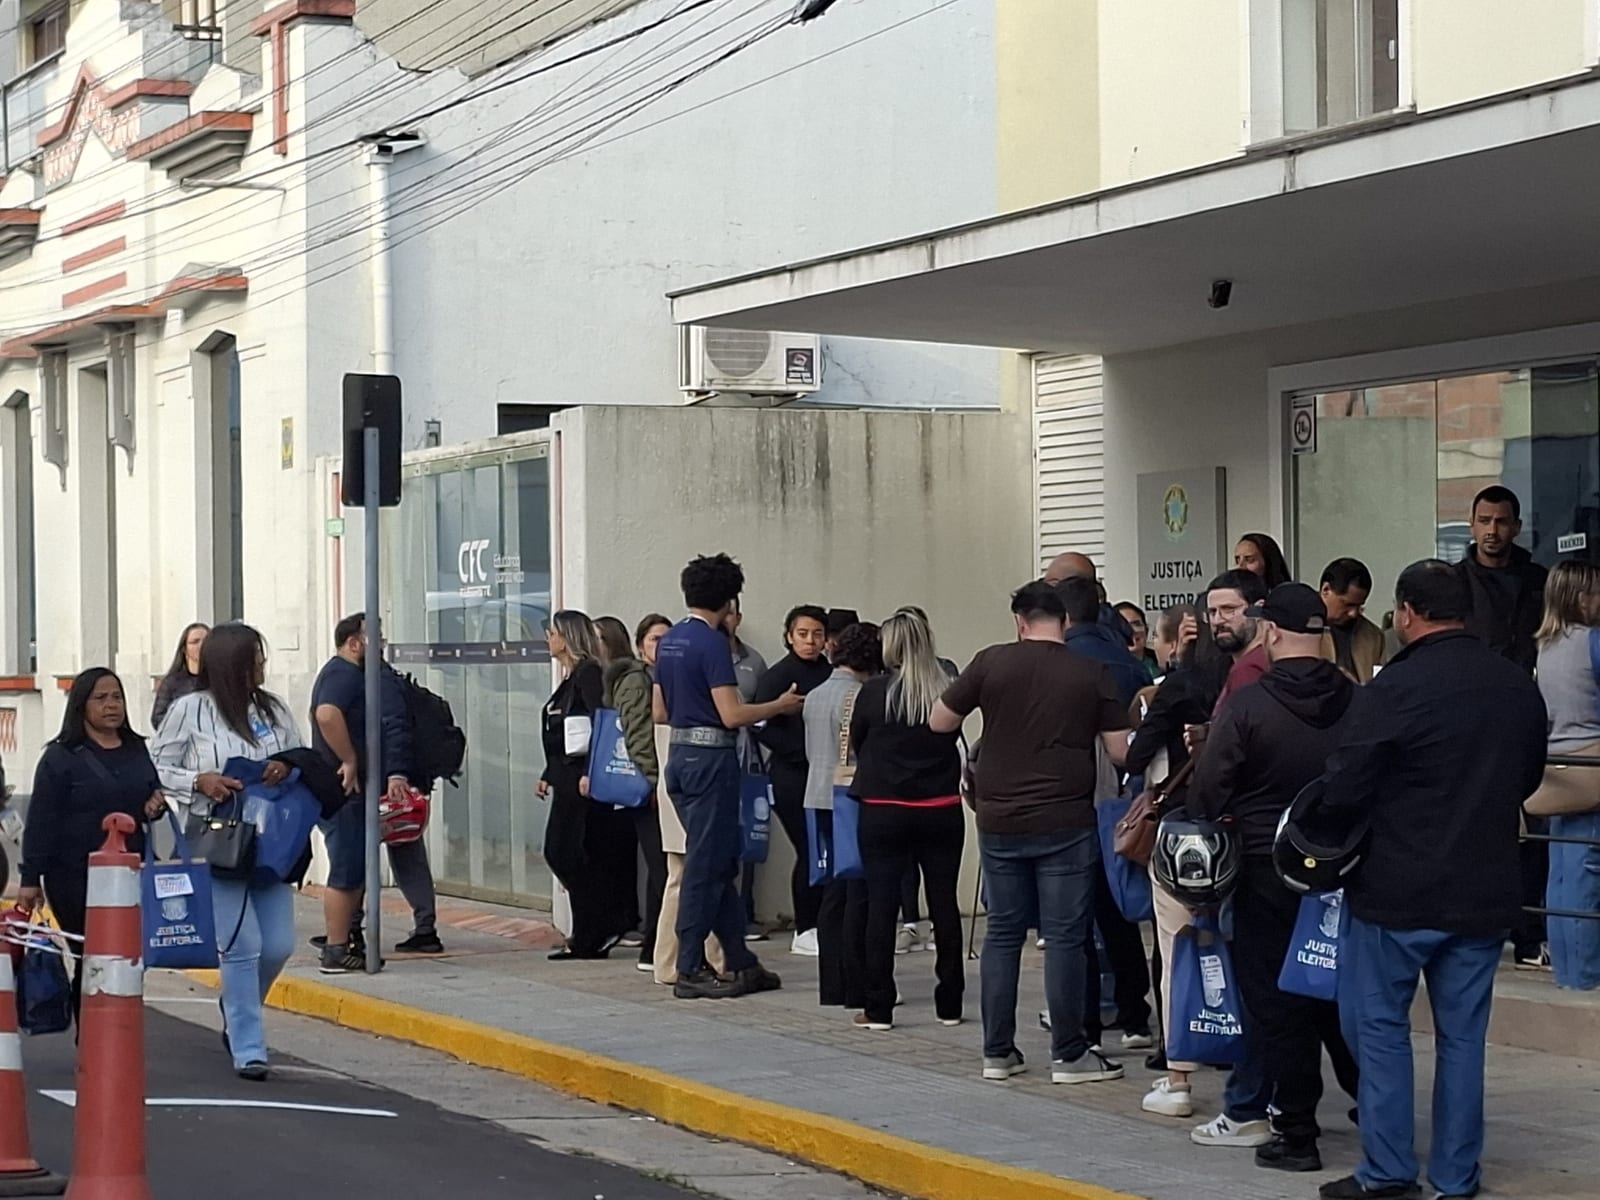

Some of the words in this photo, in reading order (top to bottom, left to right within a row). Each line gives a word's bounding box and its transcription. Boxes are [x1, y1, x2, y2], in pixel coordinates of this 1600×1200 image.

[458, 539, 490, 583] CFC
[1150, 559, 1203, 581] JUSTIÇA
[1144, 592, 1203, 611] ELEITOR
[1304, 938, 1338, 958] JUSTIÇ
